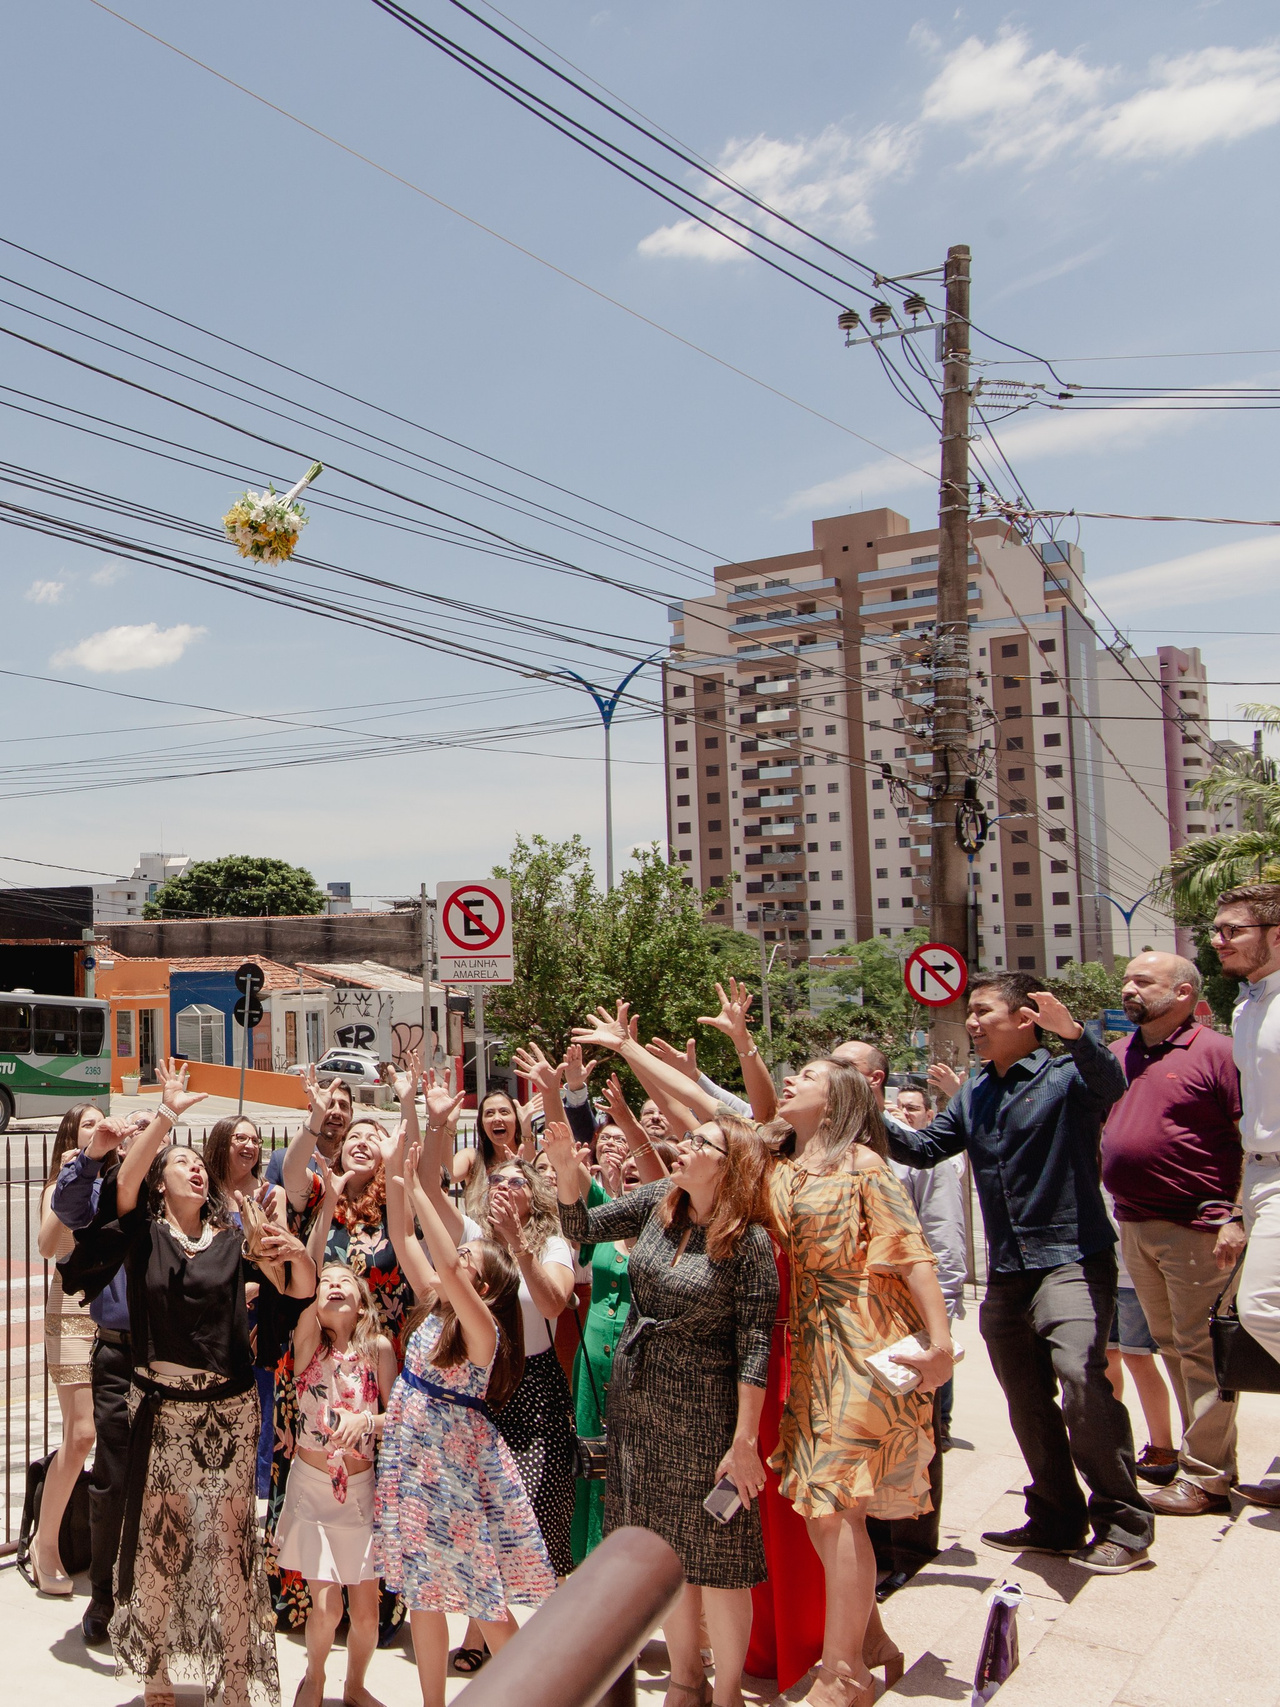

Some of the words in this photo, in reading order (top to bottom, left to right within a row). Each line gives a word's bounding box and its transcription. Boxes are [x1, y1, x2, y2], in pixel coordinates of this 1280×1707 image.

[463, 900, 485, 936] E
[453, 960, 467, 968] NA
[469, 960, 498, 968] LINHA
[453, 970, 499, 979] AMARELA
[85, 1066, 101, 1075] 2363
